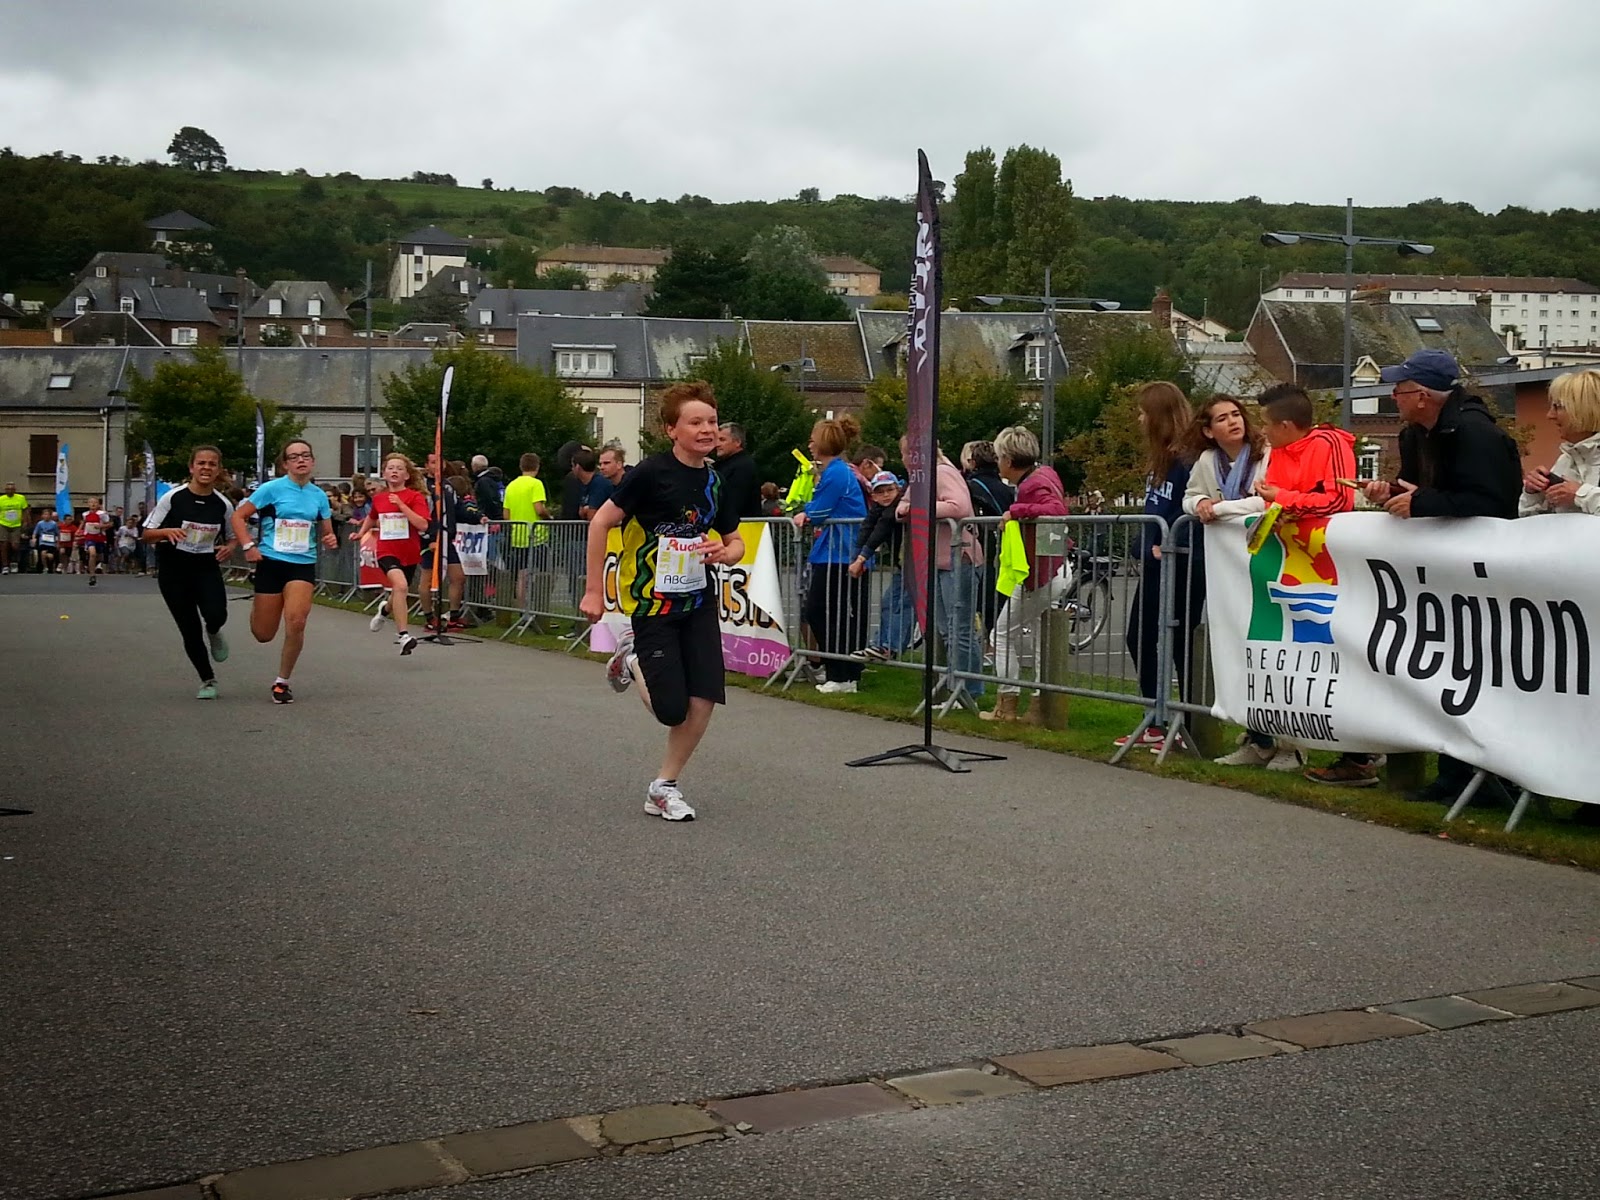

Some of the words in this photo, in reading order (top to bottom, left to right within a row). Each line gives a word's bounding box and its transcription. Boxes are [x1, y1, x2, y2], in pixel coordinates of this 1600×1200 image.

[666, 539, 703, 552] Auch
[664, 575, 688, 585] ABC
[1366, 559, 1590, 716] Région
[1246, 647, 1340, 674] REGION
[1247, 673, 1338, 708] HAUTE
[1247, 706, 1340, 742] NORMANDIE
